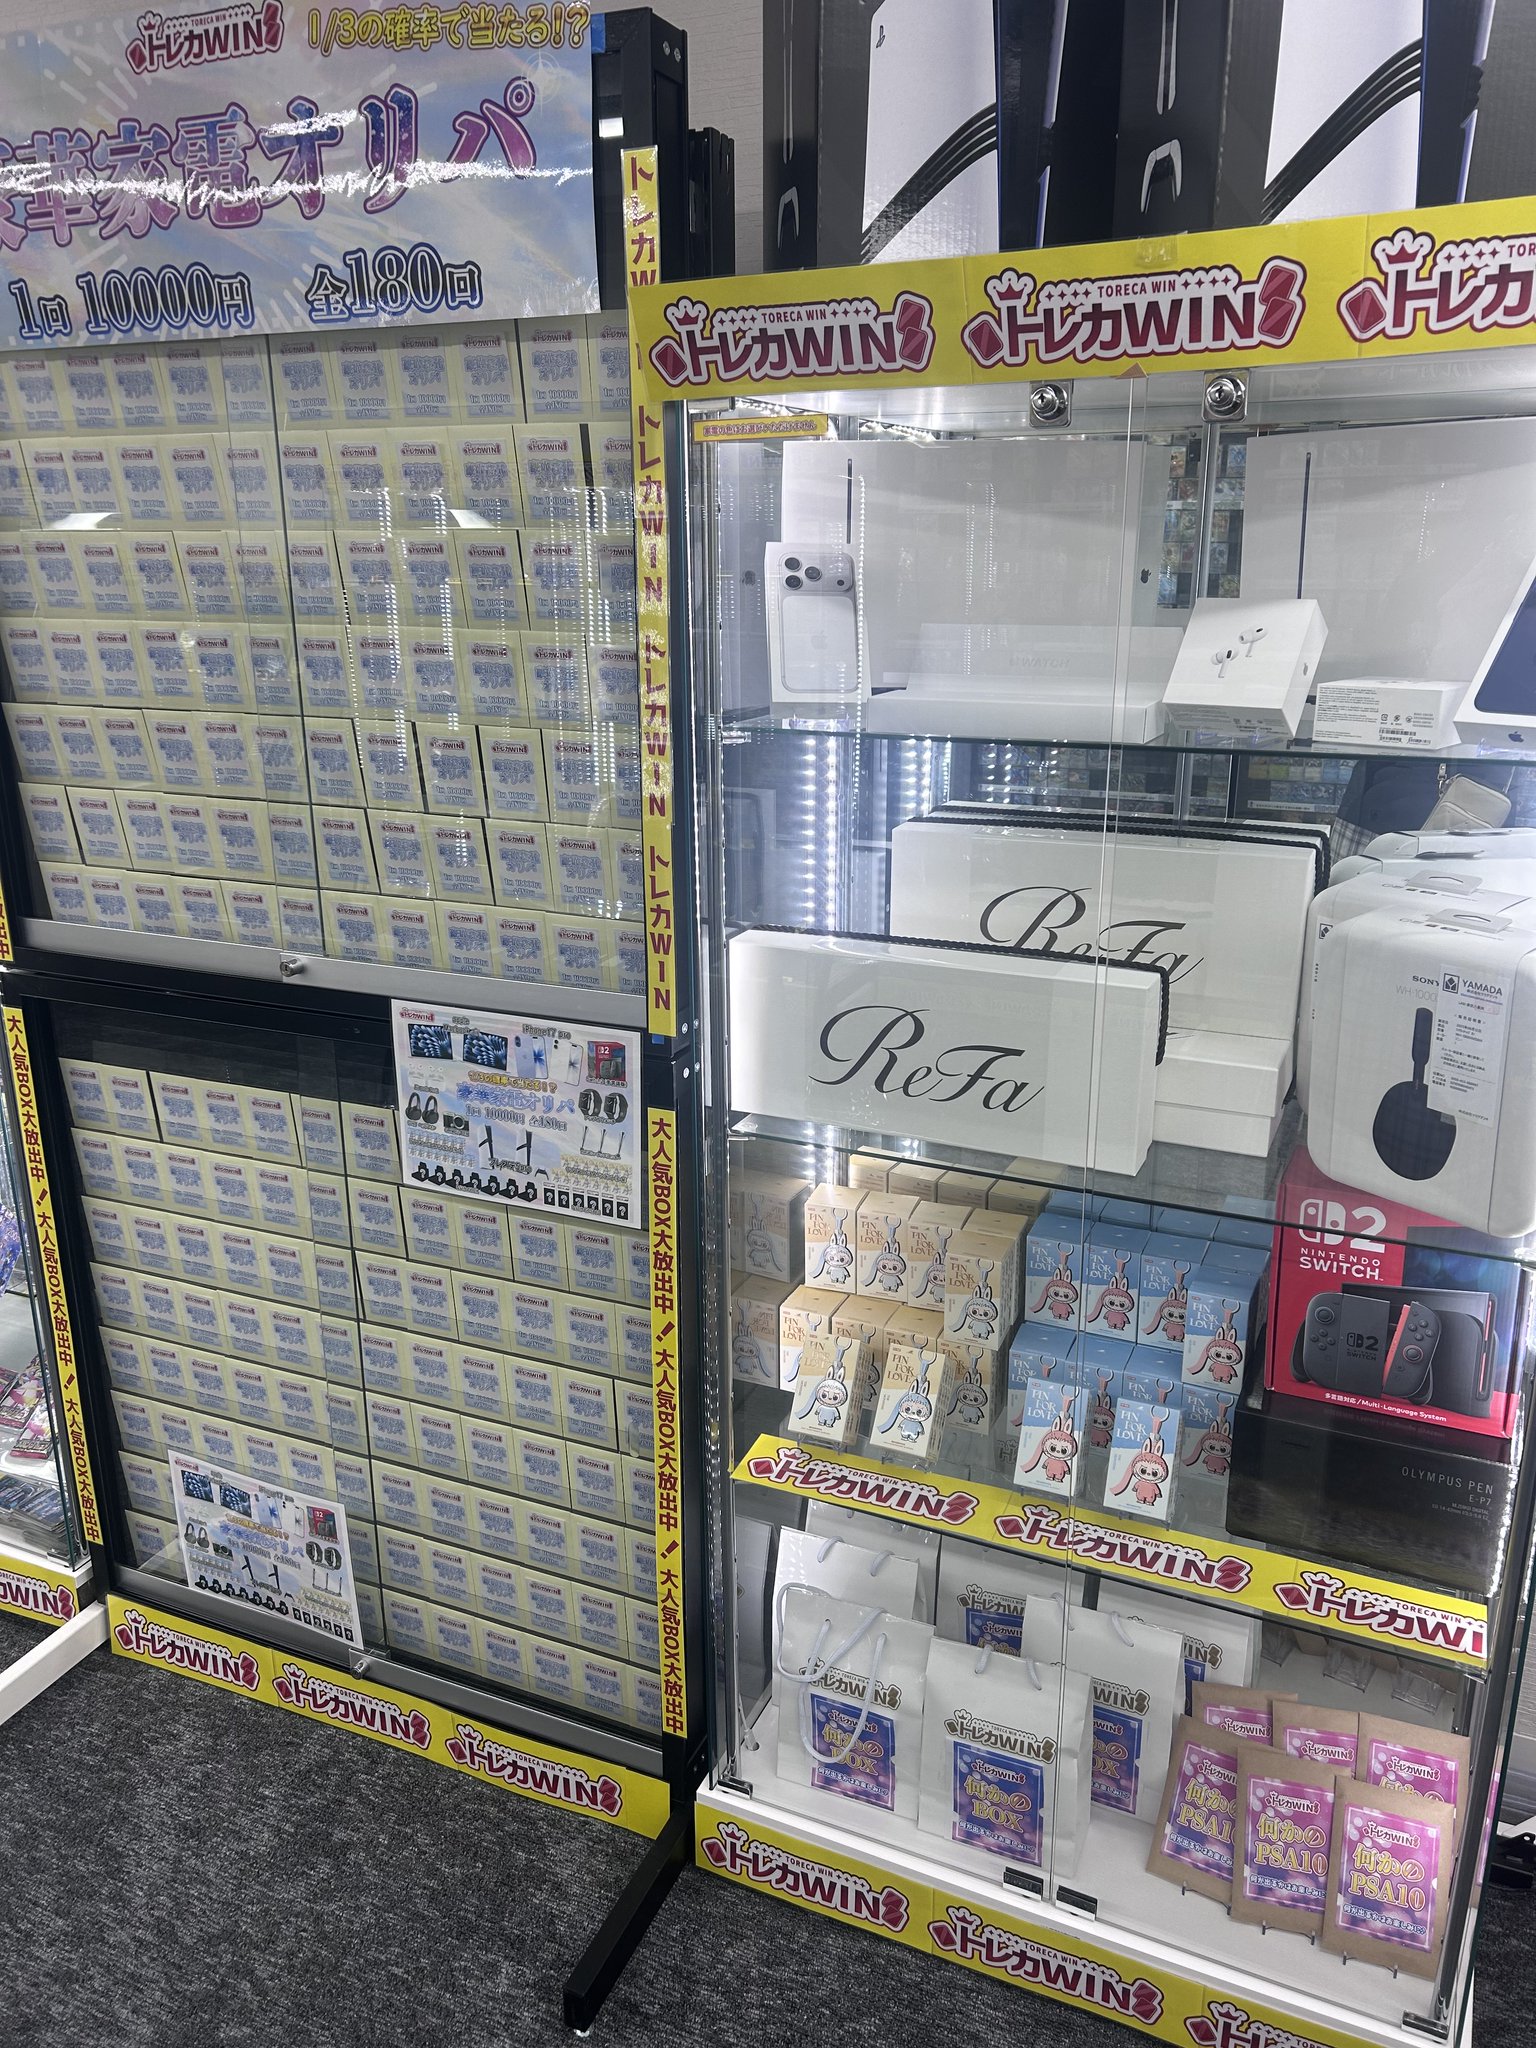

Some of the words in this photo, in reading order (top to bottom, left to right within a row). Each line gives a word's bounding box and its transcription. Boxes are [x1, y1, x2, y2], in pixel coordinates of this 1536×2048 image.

[309, 4, 588, 54] 1/3の確率で当たる!?
[148, 19, 264, 66] トレカWIN
[0, 77, 536, 250] 華家電オリパ
[9, 277, 71, 339] 1回
[77, 262, 255, 336] 10000円
[305, 242, 484, 325] 全180回
[1097, 281, 1147, 298] TORECA
[1151, 279, 1177, 294] WIN
[761, 310, 803, 324] TORECA
[805, 308, 827, 321] WIN
[1005, 291, 1258, 357] トレカWIN
[686, 321, 898, 377] トレカWIN
[637, 405, 664, 602] トレカWIN
[645, 634, 668, 818] トレカWIN
[649, 845, 673, 1011] トレカWIN
[1462, 979, 1503, 996] YAMADA
[809, 1005, 1044, 1113] ReFa
[861, 1221, 877, 1230] PIN
[865, 1229, 885, 1240] FOR
[860, 1235, 883, 1246] LOVE
[951, 1262, 967, 1273] PIN
[1299, 1254, 1380, 1281] SWITCH
[1300, 1247, 1381, 1267] NINTENDO
[950, 1277, 975, 1290] LOVE
[955, 1271, 976, 1284] FOR
[1192, 1302, 1211, 1313] PIN
[1196, 1311, 1218, 1324] FOR
[1190, 1318, 1218, 1331] LOVE
[1032, 1389, 1050, 1401] PIN
[1036, 1398, 1057, 1412] FOR
[1027, 1407, 1055, 1420] LOVE
[1120, 1410, 1139, 1422] PIN
[1419, 1411, 1447, 1422] System
[1116, 1428, 1145, 1441] LOVE
[1124, 1420, 1148, 1436] FOR
[65, 1397, 100, 1542] 大人気BOX大放出中
[848, 1469, 880, 1482] TORECA
[881, 1475, 898, 1486] WIN
[1402, 1466, 1462, 1488] OLYMPUS
[1468, 1480, 1493, 1495] PEN
[775, 1460, 946, 1517] トレカWIN
[1469, 1494, 1491, 1506] E-P7
[1026, 1518, 1215, 1584] トレカWIN
[1103, 1530, 1139, 1544] TORECA
[1142, 1538, 1160, 1549] WIN
[1395, 1601, 1437, 1618] TORECA
[1440, 1612, 1462, 1624] WIN
[135, 1626, 241, 1682] トレカWIN
[659, 1568, 684, 1734] 大人気BOX大放出中
[336, 1688, 360, 1701] TORECA
[361, 1695, 373, 1705] WIN
[293, 1680, 411, 1740] トレカWIN
[959, 1720, 1042, 1759] トレカWIN
[514, 1752, 541, 1766] TORECA
[542, 1762, 556, 1771] WIN
[1308, 1745, 1349, 1760] トレカWIN
[469, 1742, 598, 1806] トレカWIN
[978, 1764, 1019, 1782] トレカWIN
[1393, 1760, 1434, 1780] トレカWIN
[964, 1775, 1032, 1811] 何かの
[1271, 1796, 1313, 1813] トレカWIN
[971, 1799, 1024, 1834] BOX
[1175, 1802, 1236, 1846] PSA1
[1256, 1812, 1327, 1848] 何かの
[1370, 1827, 1413, 1846] トレカWIN
[785, 1855, 816, 1872] TORECA
[817, 1866, 833, 1878] WIN
[1254, 1840, 1329, 1877] PSA10
[1353, 1842, 1425, 1882] 何かの
[729, 1842, 880, 1920] トレカWIN
[1348, 1870, 1426, 1912] PSA10
[1023, 1941, 1058, 1960] TORECA
[1060, 1954, 1078, 1966] WIN
[960, 1926, 1131, 2011] トレカWIN
